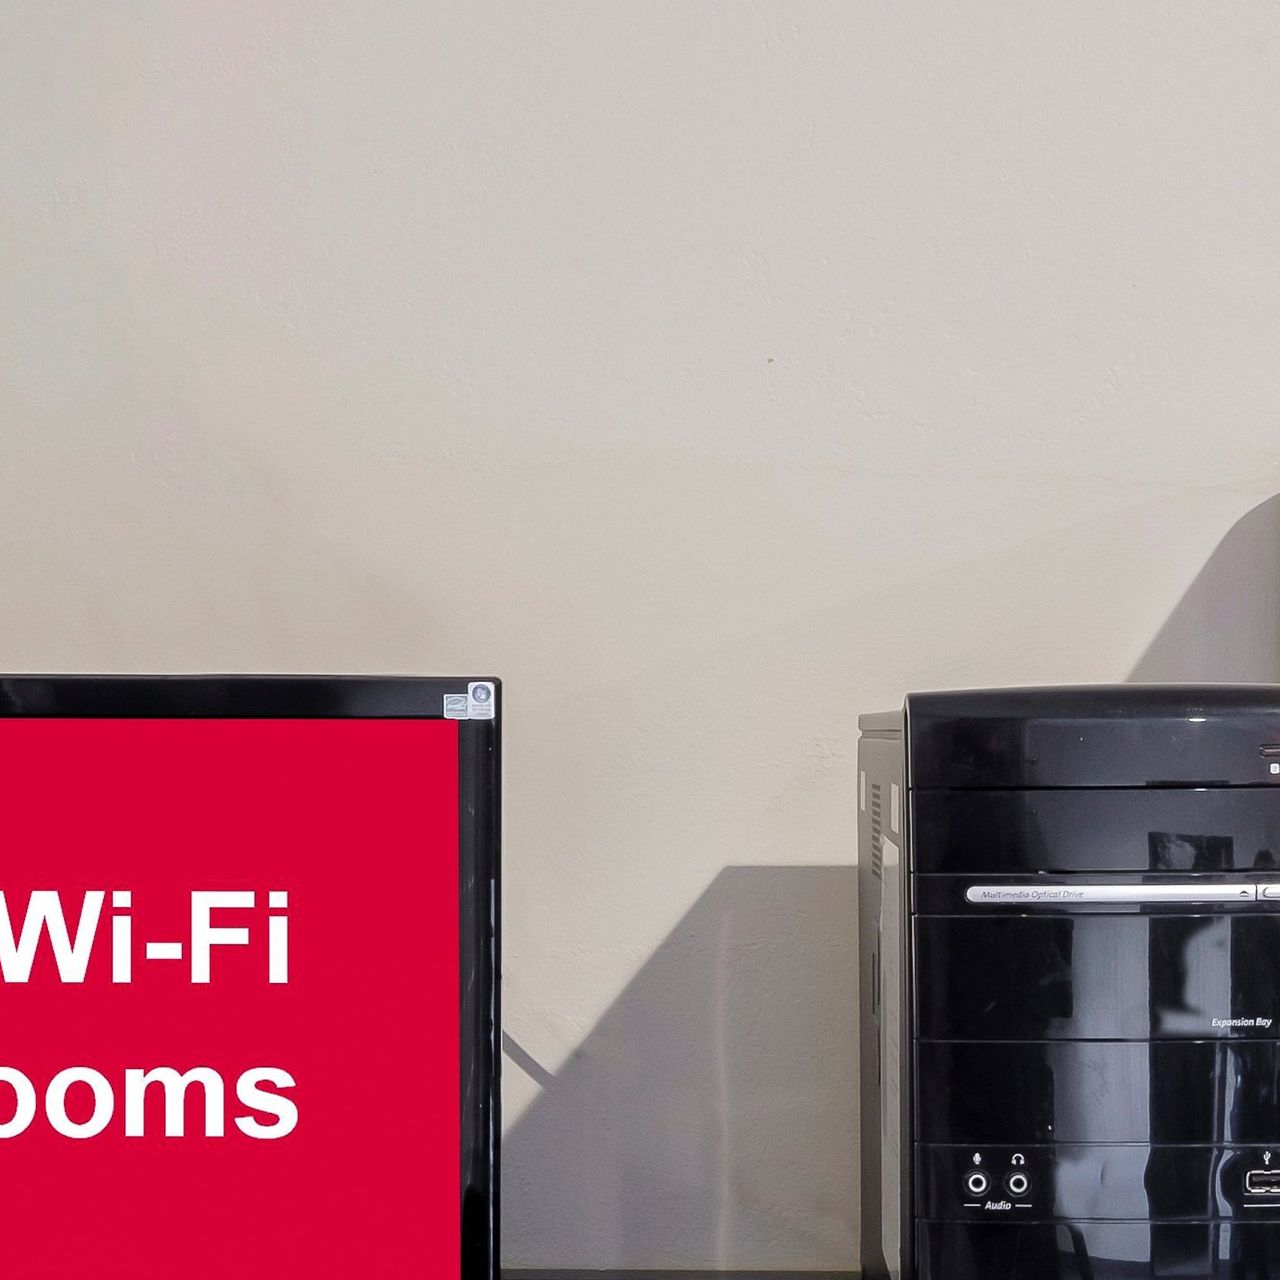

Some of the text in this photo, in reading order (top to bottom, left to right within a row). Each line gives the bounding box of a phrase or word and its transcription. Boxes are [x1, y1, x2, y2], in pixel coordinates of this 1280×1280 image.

[981, 890, 1085, 901] Multimedia Optical Drive
[1211, 1017, 1273, 1031] Expansion Bay
[984, 1199, 1012, 1212] Audio
